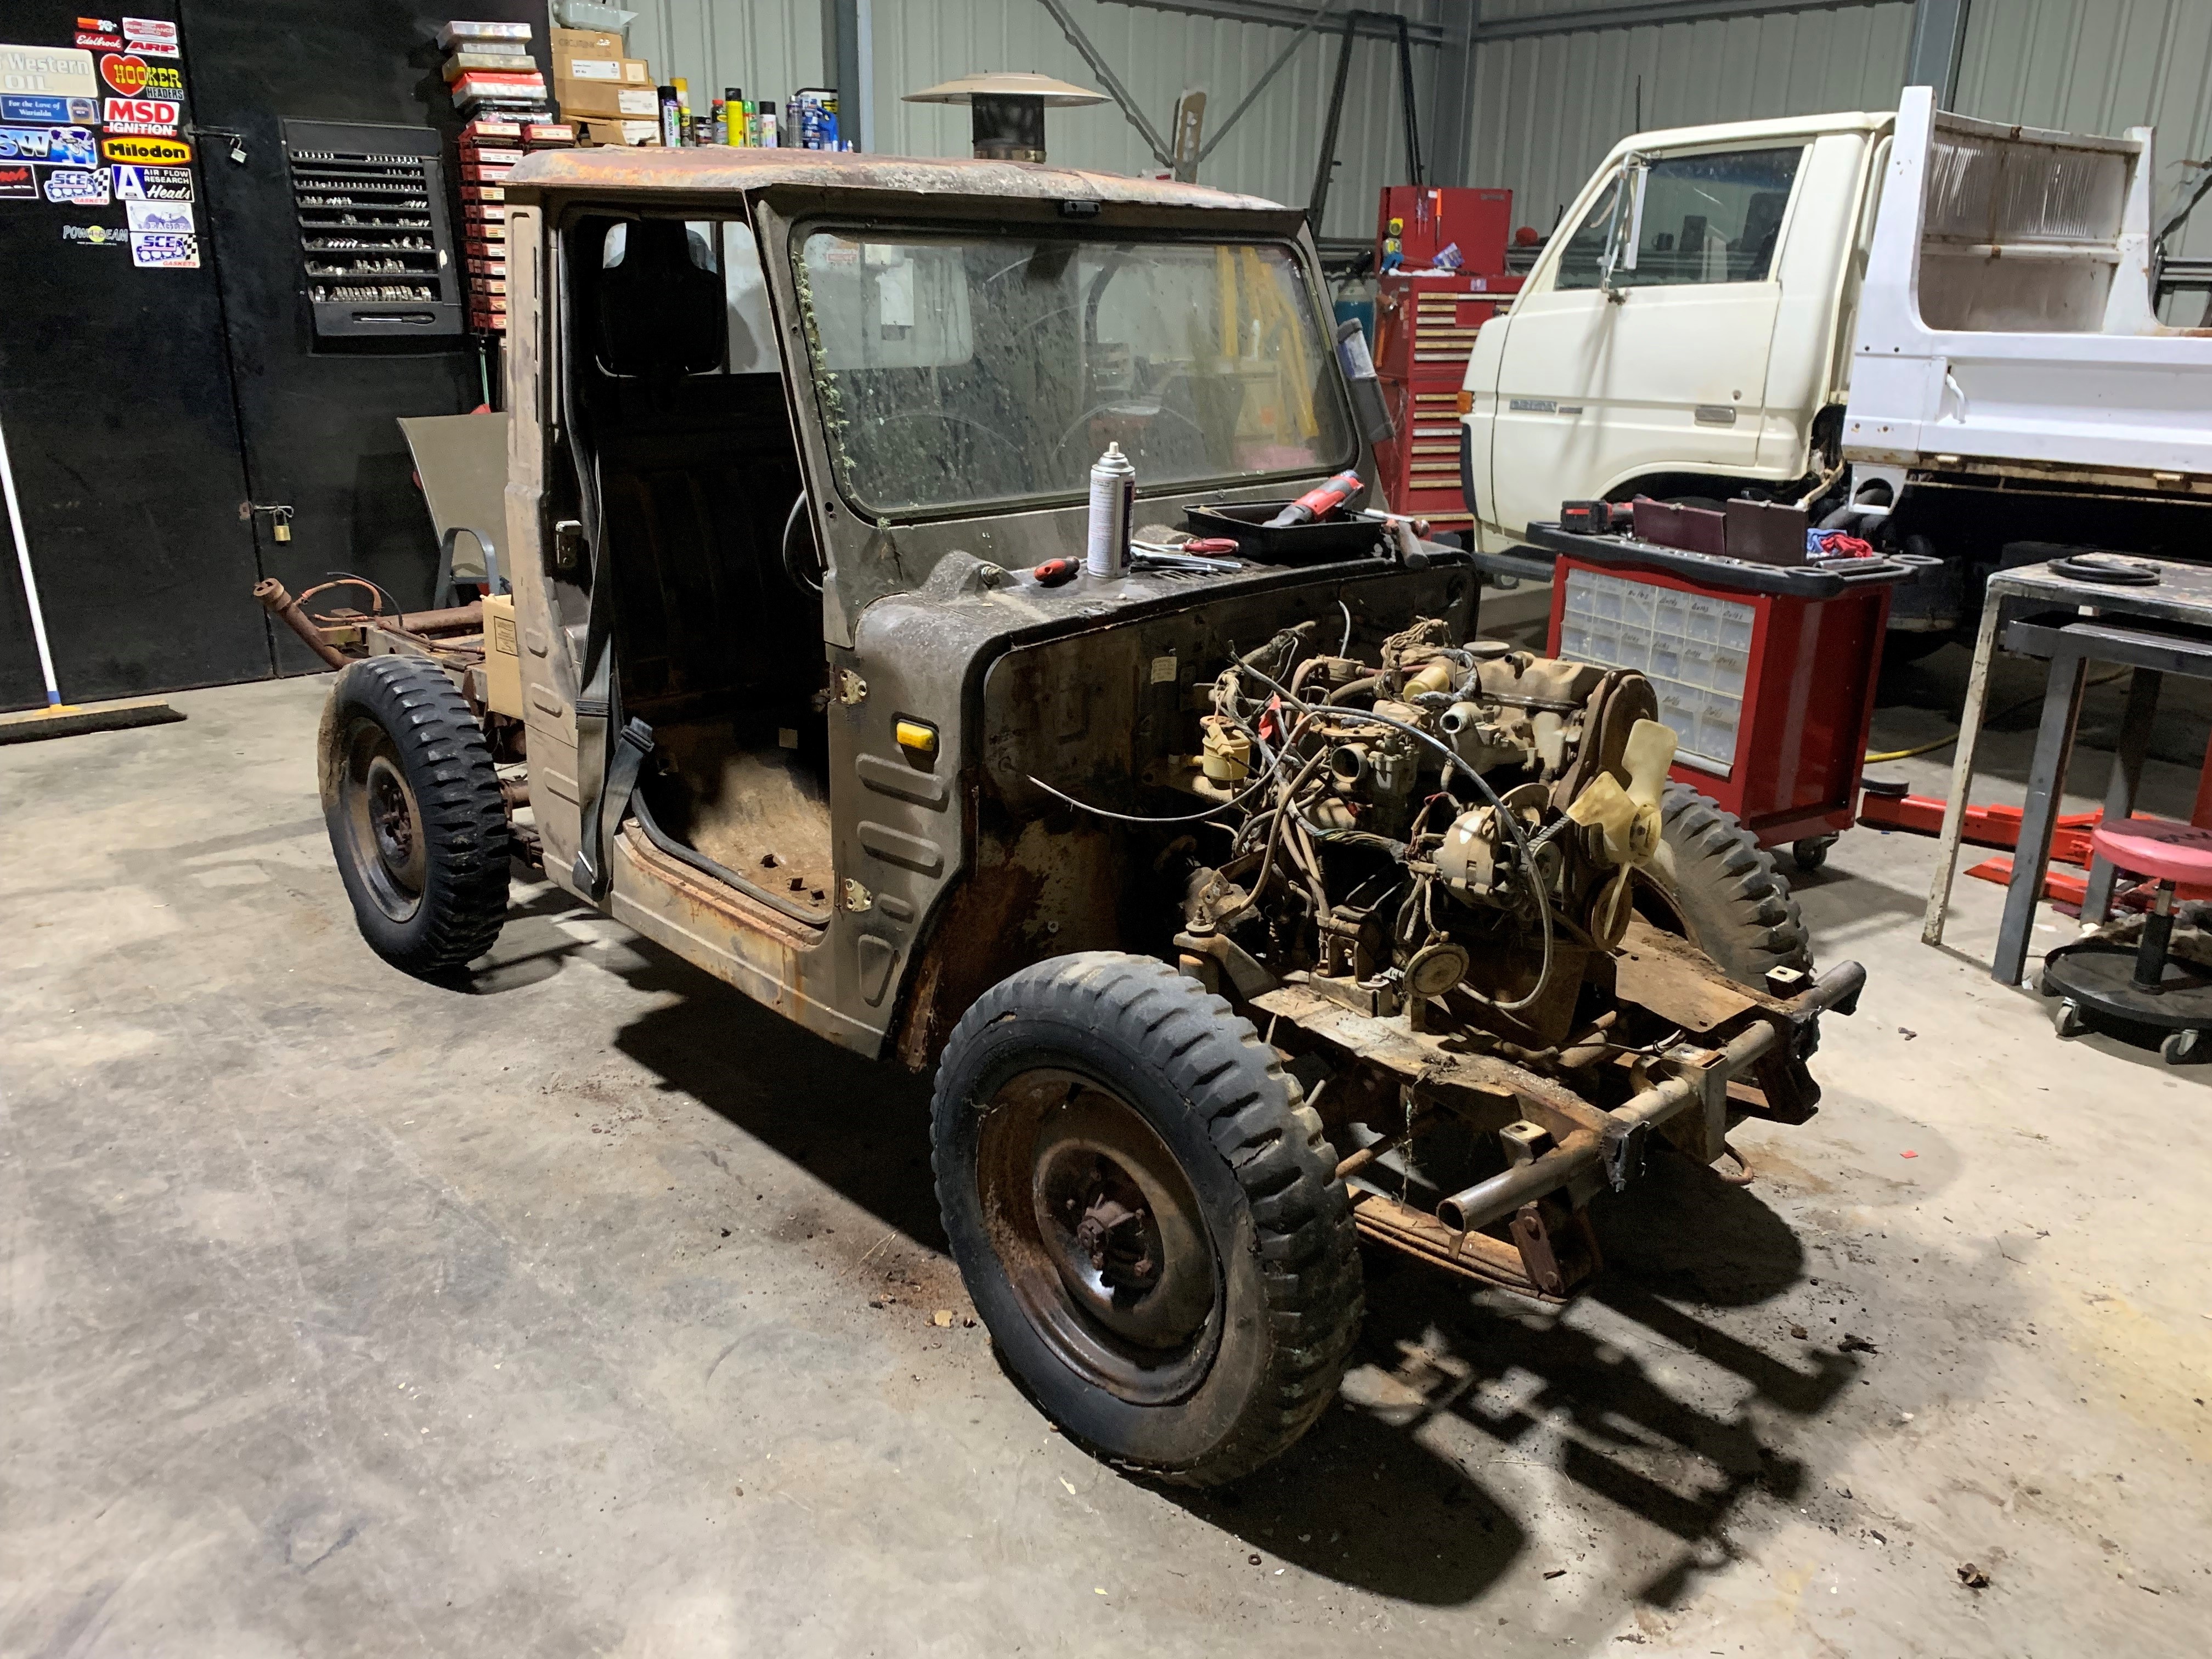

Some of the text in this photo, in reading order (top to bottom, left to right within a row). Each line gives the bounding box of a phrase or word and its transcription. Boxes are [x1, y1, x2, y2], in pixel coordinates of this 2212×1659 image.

[77, 35, 121, 48] Edelbrock
[129, 42, 176, 52] ARP
[7, 53, 89, 75] Western
[4, 74, 53, 91] OIL
[113, 64, 182, 88] HOOKER
[146, 88, 184, 99] HEADERS
[53, 101, 60, 110] of
[109, 100, 174, 123] MSD
[109, 122, 173, 136] IGNITION
[108, 143, 186, 159] Milodon
[55, 173, 86, 185] SCE
[144, 176, 189, 184] RESEARCH
[146, 184, 190, 199] Heads
[149, 221, 186, 231] EAGLE
[144, 235, 176, 247] SCE
